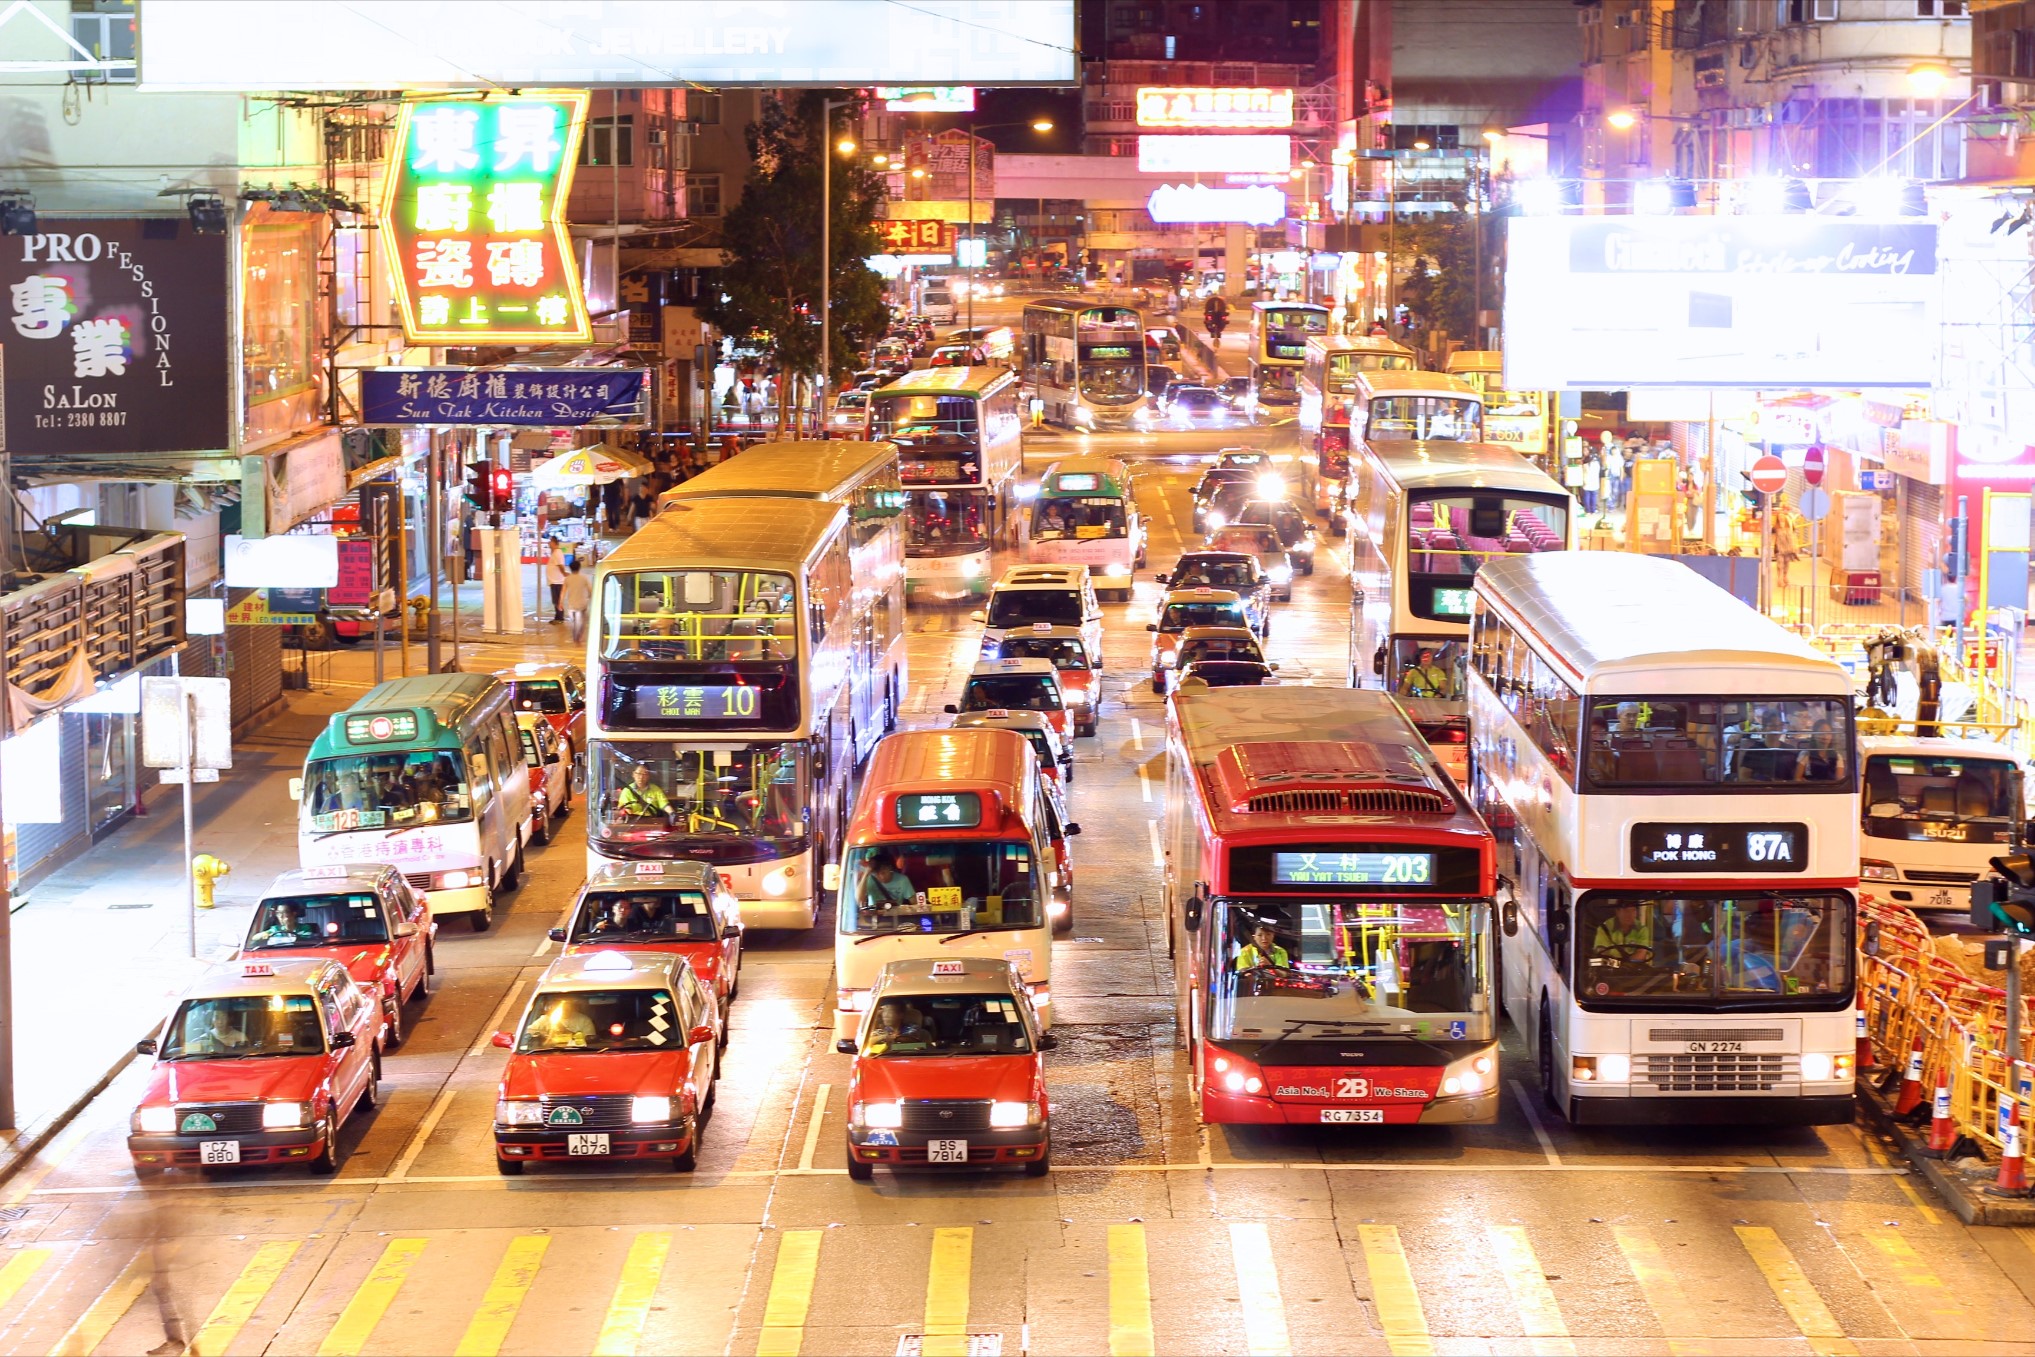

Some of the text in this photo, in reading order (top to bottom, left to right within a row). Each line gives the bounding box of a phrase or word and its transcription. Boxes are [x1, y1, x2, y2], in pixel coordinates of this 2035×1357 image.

[589, 27, 792, 56] JEWELLERY
[1835, 243, 1915, 275] Cooking
[396, 403, 430, 419] Sun
[478, 402, 543, 418] Kitchen
[35, 412, 127, 428] Tel: 2380 8807
[656, 687, 704, 707] 彩雲
[721, 686, 755, 716] 10
[660, 708, 701, 716] CHOI WAN
[988, 710, 1006, 718] TAXI
[1923, 829, 1967, 839] ISUZU
[1748, 834, 1791, 861] 87A
[1653, 850, 1717, 861] POK HONG
[1298, 853, 1360, 871] 又一村
[307, 867, 343, 877] TAXI
[639, 864, 661, 872] TAXI
[1381, 855, 1428, 883] 203
[1312, 871, 1333, 881] YAT
[1929, 897, 1953, 905] 7016
[245, 965, 269, 974] TAXI
[936, 964, 961, 972] TAXI
[1689, 1042, 1742, 1052] GN 2274
[1275, 1086, 1300, 1095] Asia
[1375, 1087, 1392, 1096] We
[1394, 1087, 1429, 1098] Share.
[1324, 1111, 1379, 1121] RG 7354
[579, 1135, 599, 1144] NJ
[211, 1142, 228, 1152] CZ
[571, 1145, 608, 1155] 4073
[939, 1141, 956, 1150] BS
[207, 1152, 234, 1162] 880
[932, 1151, 964, 1162] 7814
